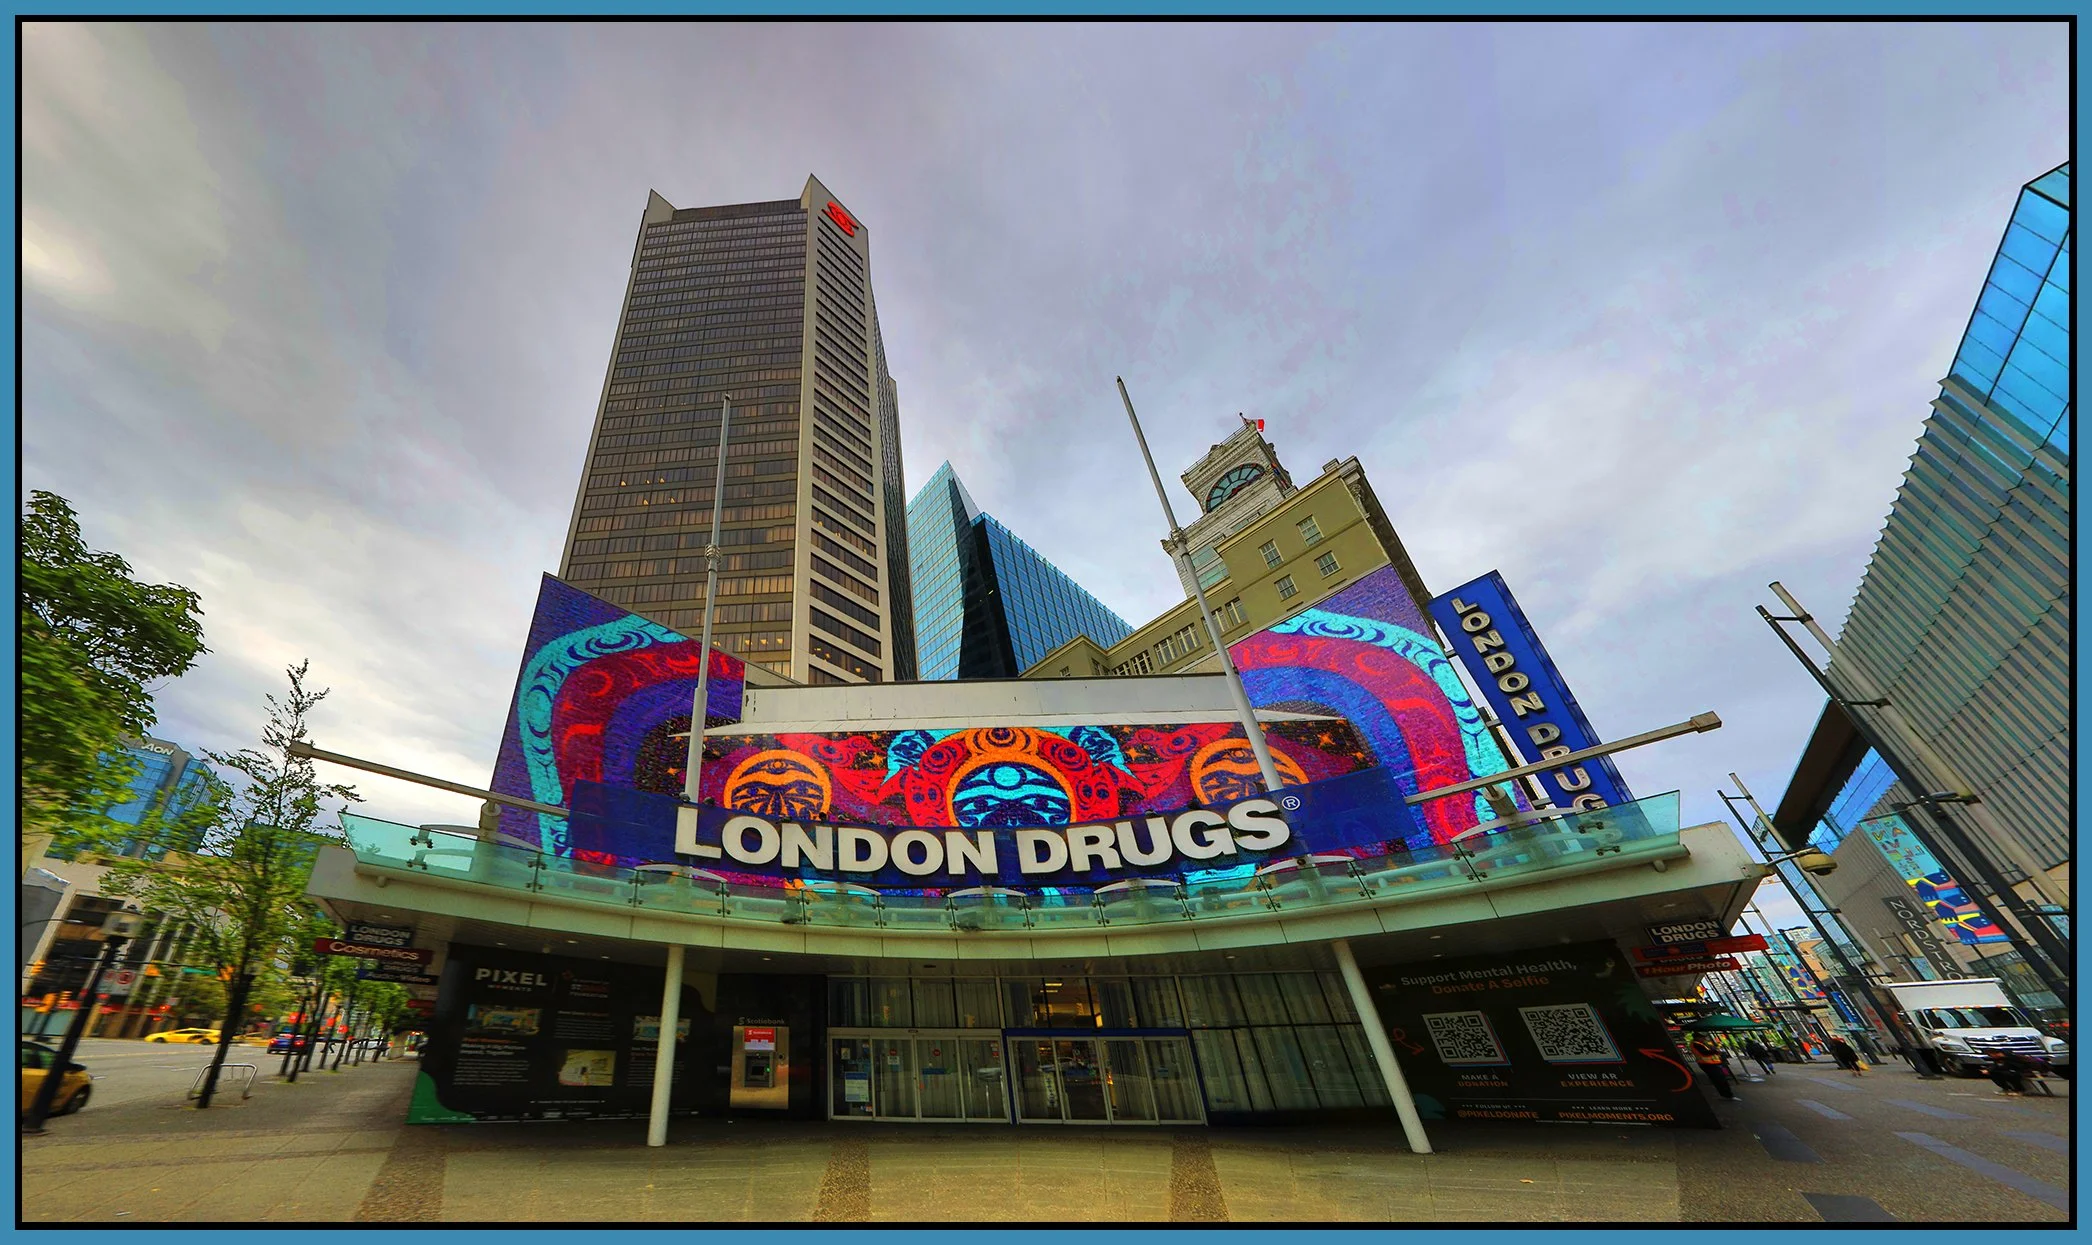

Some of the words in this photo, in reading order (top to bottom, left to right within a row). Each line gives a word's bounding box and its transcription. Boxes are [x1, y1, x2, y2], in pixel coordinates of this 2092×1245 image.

[1451, 597, 1547, 717] LONDON
[141, 743, 174, 756] AON
[674, 807, 1000, 876] LONDON
[1018, 799, 1292, 875] DRUGS
[350, 924, 412, 939] LONDON
[1651, 921, 1720, 936] LONDON
[352, 934, 406, 946] DRUGS
[1661, 929, 1720, 943] DRUGS
[329, 941, 420, 961] Cosmetics
[1687, 960, 1731, 971] Photo
[474, 967, 548, 987] PIXEL
[1400, 972, 1458, 987] Support
[1459, 965, 1514, 981] Mental
[1515, 959, 1577, 975] Health,
[1431, 980, 1485, 995] Donate
[1488, 979, 1500, 990] A
[1502, 974, 1551, 989] Selfie
[746, 1016, 785, 1025] Scotiabank
[1601, 1072, 1619, 1080] AR
[1560, 1080, 1636, 1088] EXPERIENCE
[1456, 1109, 1541, 1120] @PIXELDONATE
[1557, 1111, 1675, 1121] PIXELMOMENTS.ORG
